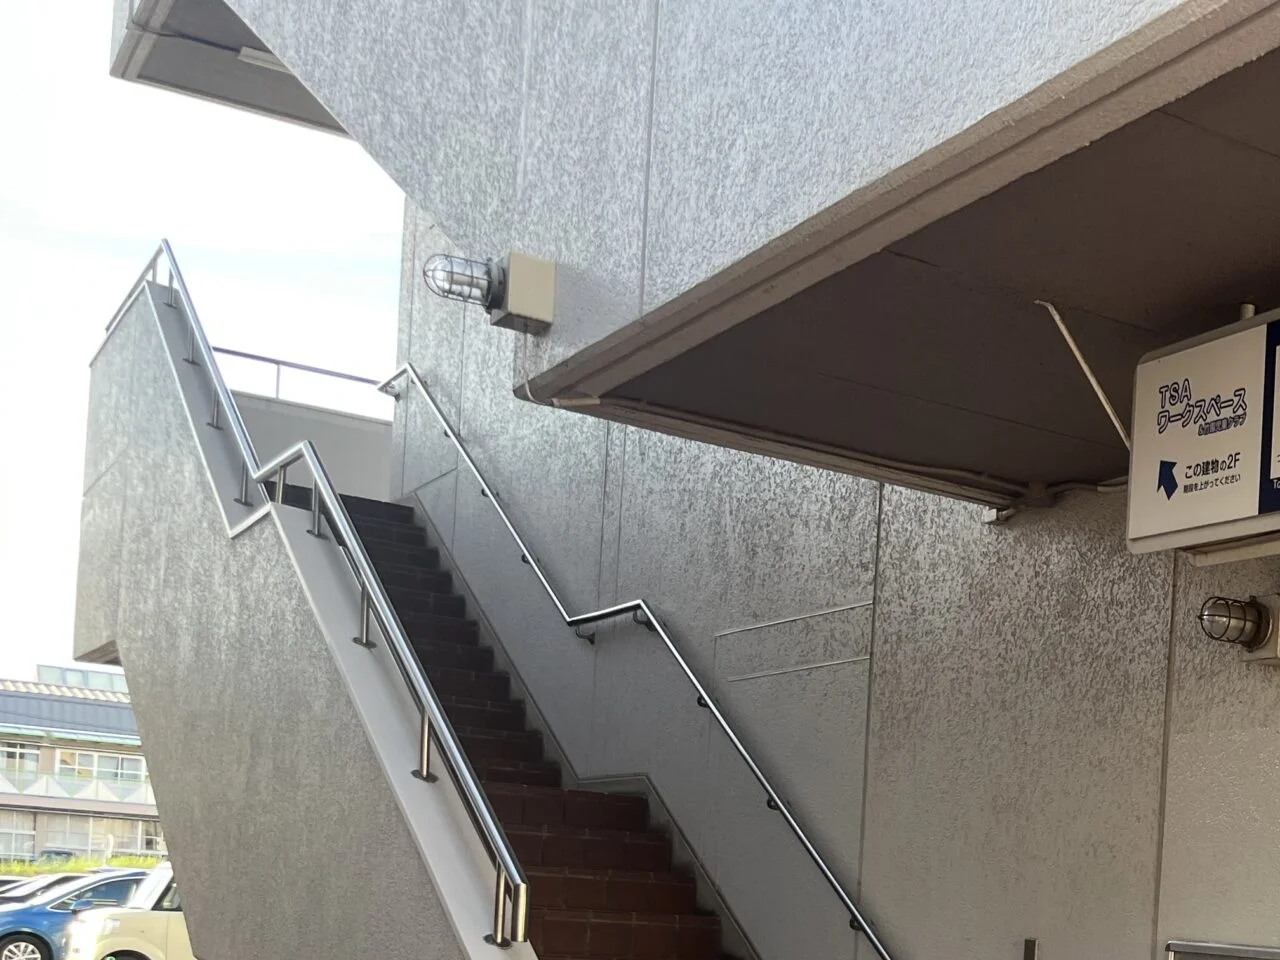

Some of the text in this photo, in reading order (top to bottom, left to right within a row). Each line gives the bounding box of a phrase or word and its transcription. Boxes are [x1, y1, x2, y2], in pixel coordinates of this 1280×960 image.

[1158, 378, 1192, 409] TSA
[1157, 388, 1248, 434] ワークスペース
[1184, 452, 1241, 479] この建物の2F
